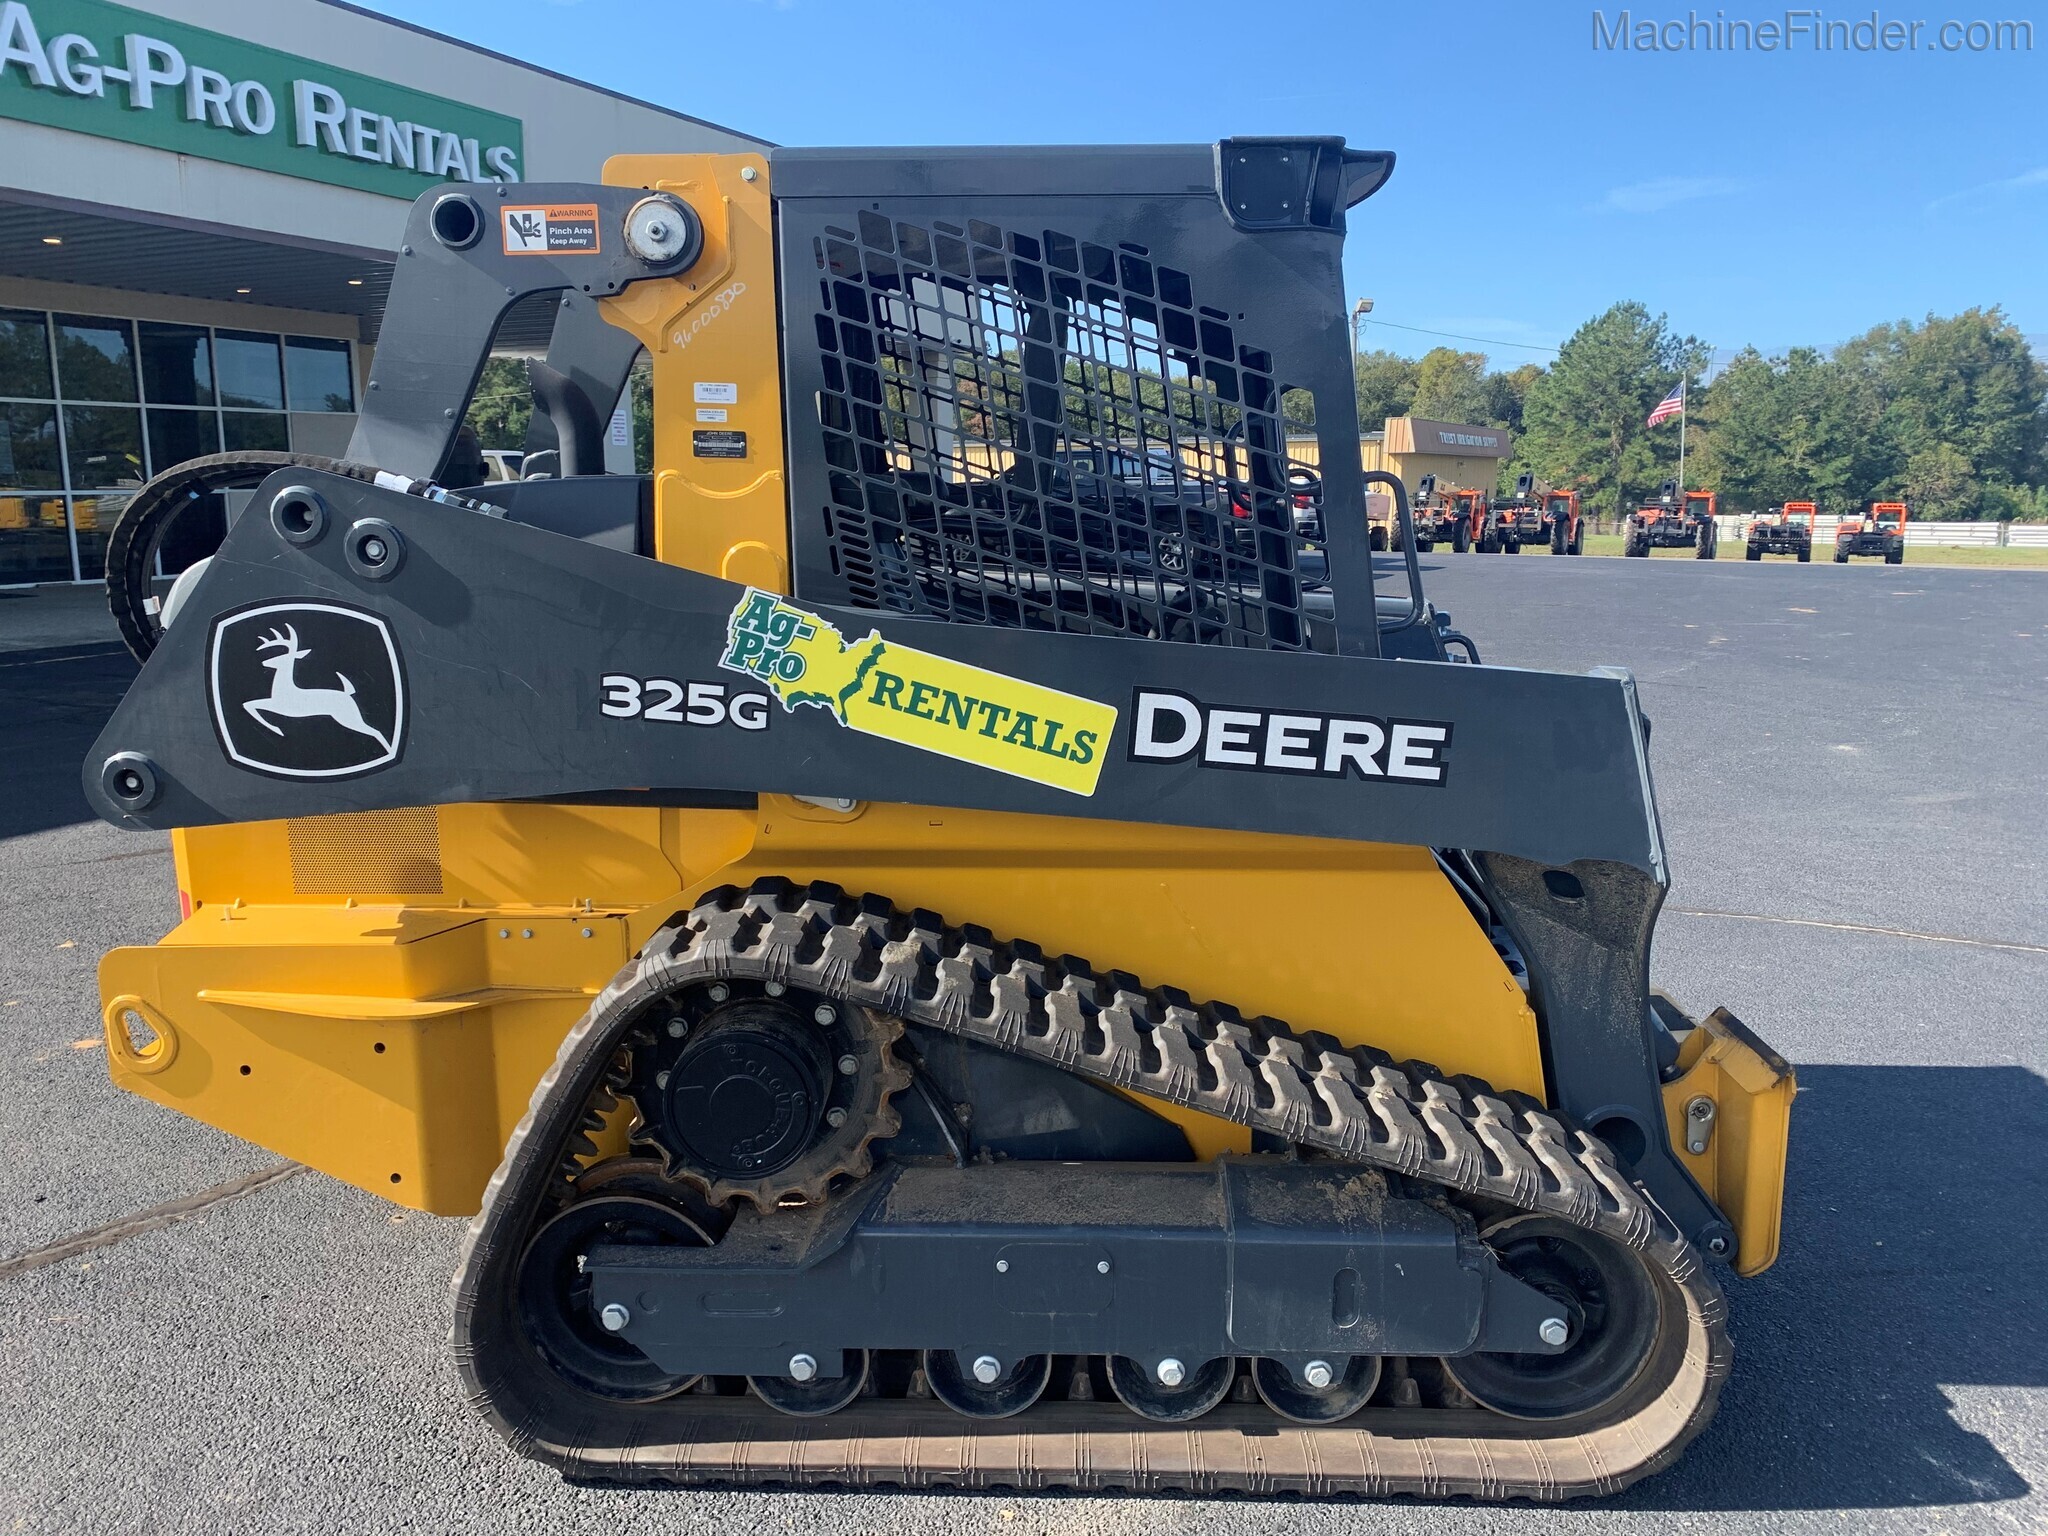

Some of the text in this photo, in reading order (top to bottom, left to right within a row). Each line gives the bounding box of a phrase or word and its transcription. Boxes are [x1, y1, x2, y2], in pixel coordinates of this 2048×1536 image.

[293, 79, 520, 183] RENTALS
[549, 227, 593, 235] Pinch Area
[549, 237, 587, 246] Keep Away
[557, 209, 593, 217] WARNING
[735, 592, 816, 649] Ag-
[726, 629, 806, 682] Pro
[601, 674, 769, 731] 325G
[867, 669, 1099, 766] RENTALS
[1133, 692, 1447, 780] DEERE
